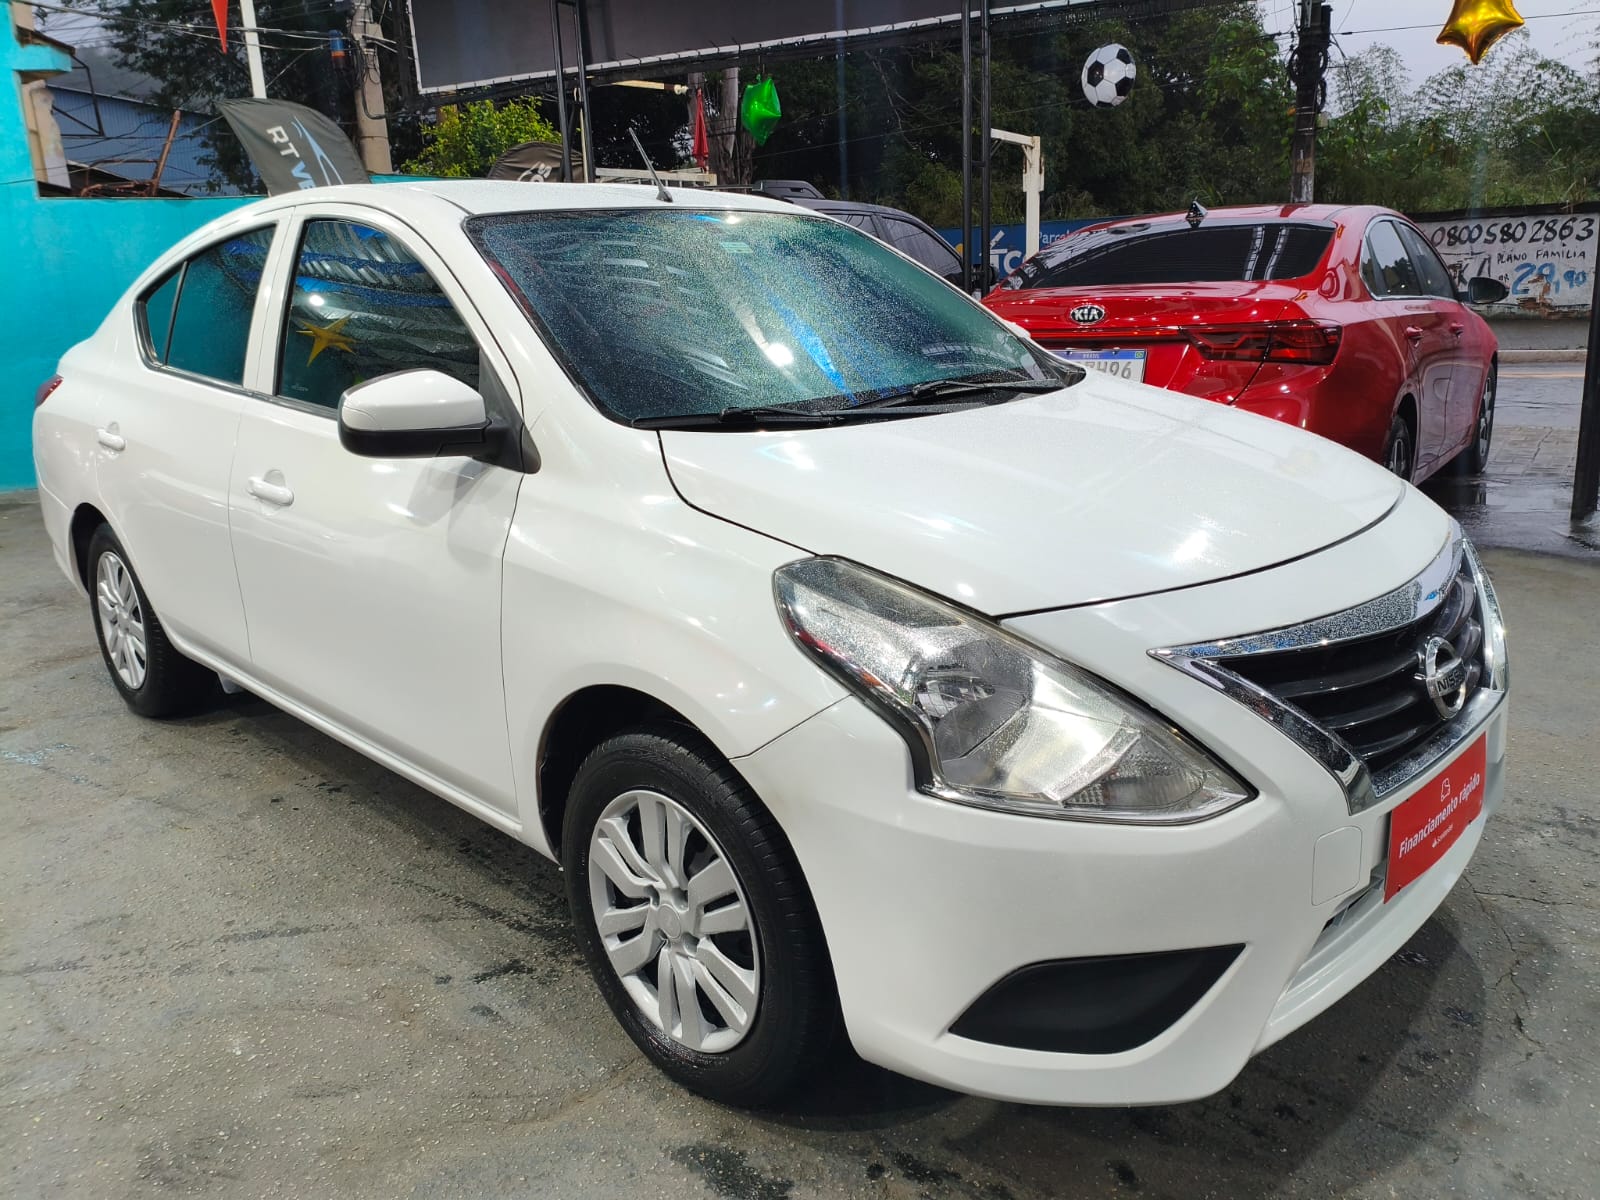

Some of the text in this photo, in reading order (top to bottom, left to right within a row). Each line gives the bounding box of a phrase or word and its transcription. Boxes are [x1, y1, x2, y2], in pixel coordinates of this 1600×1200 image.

[267, 125, 300, 158] RT
[1074, 308, 1100, 321] KIA
[1399, 797, 1458, 859] Financiamento
[1459, 772, 1481, 804] rápido
